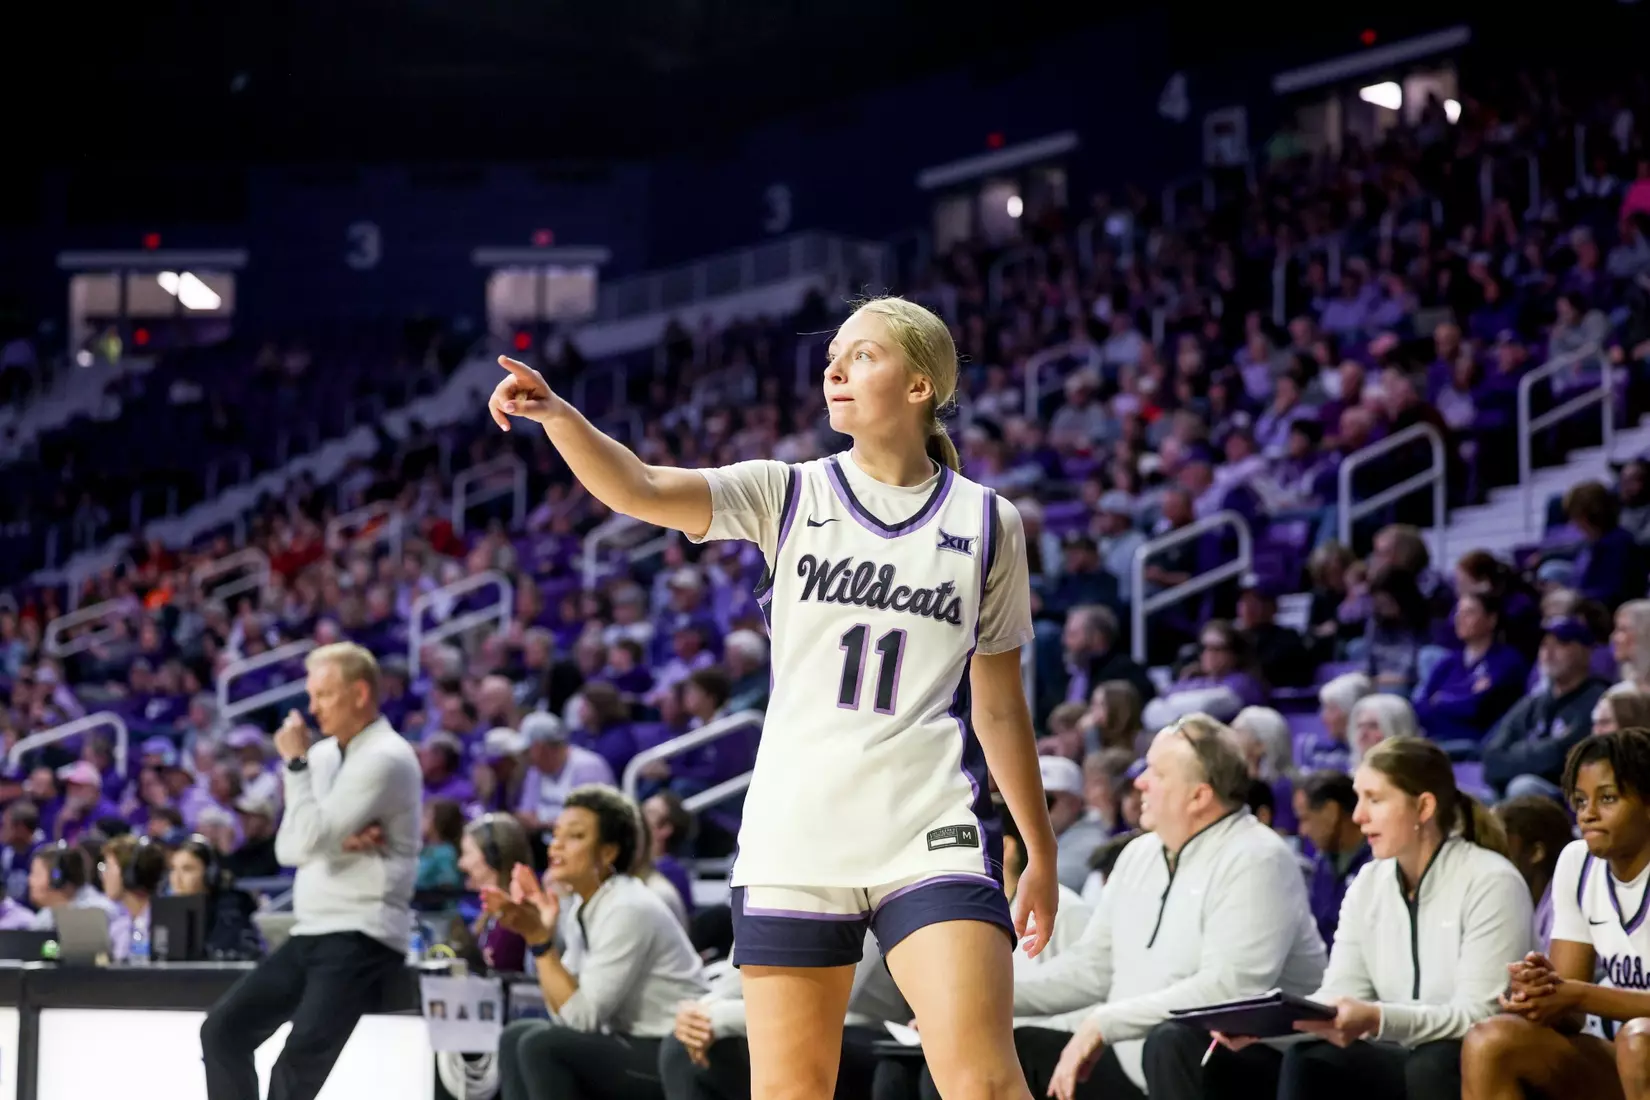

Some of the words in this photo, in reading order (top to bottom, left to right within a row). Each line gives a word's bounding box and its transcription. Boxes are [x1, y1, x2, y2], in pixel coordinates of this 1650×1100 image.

[763, 184, 791, 232] 3
[347, 222, 381, 269] 3
[797, 553, 962, 626] Wildcats
[836, 622, 907, 716] 11
[962, 831, 972, 840] M
